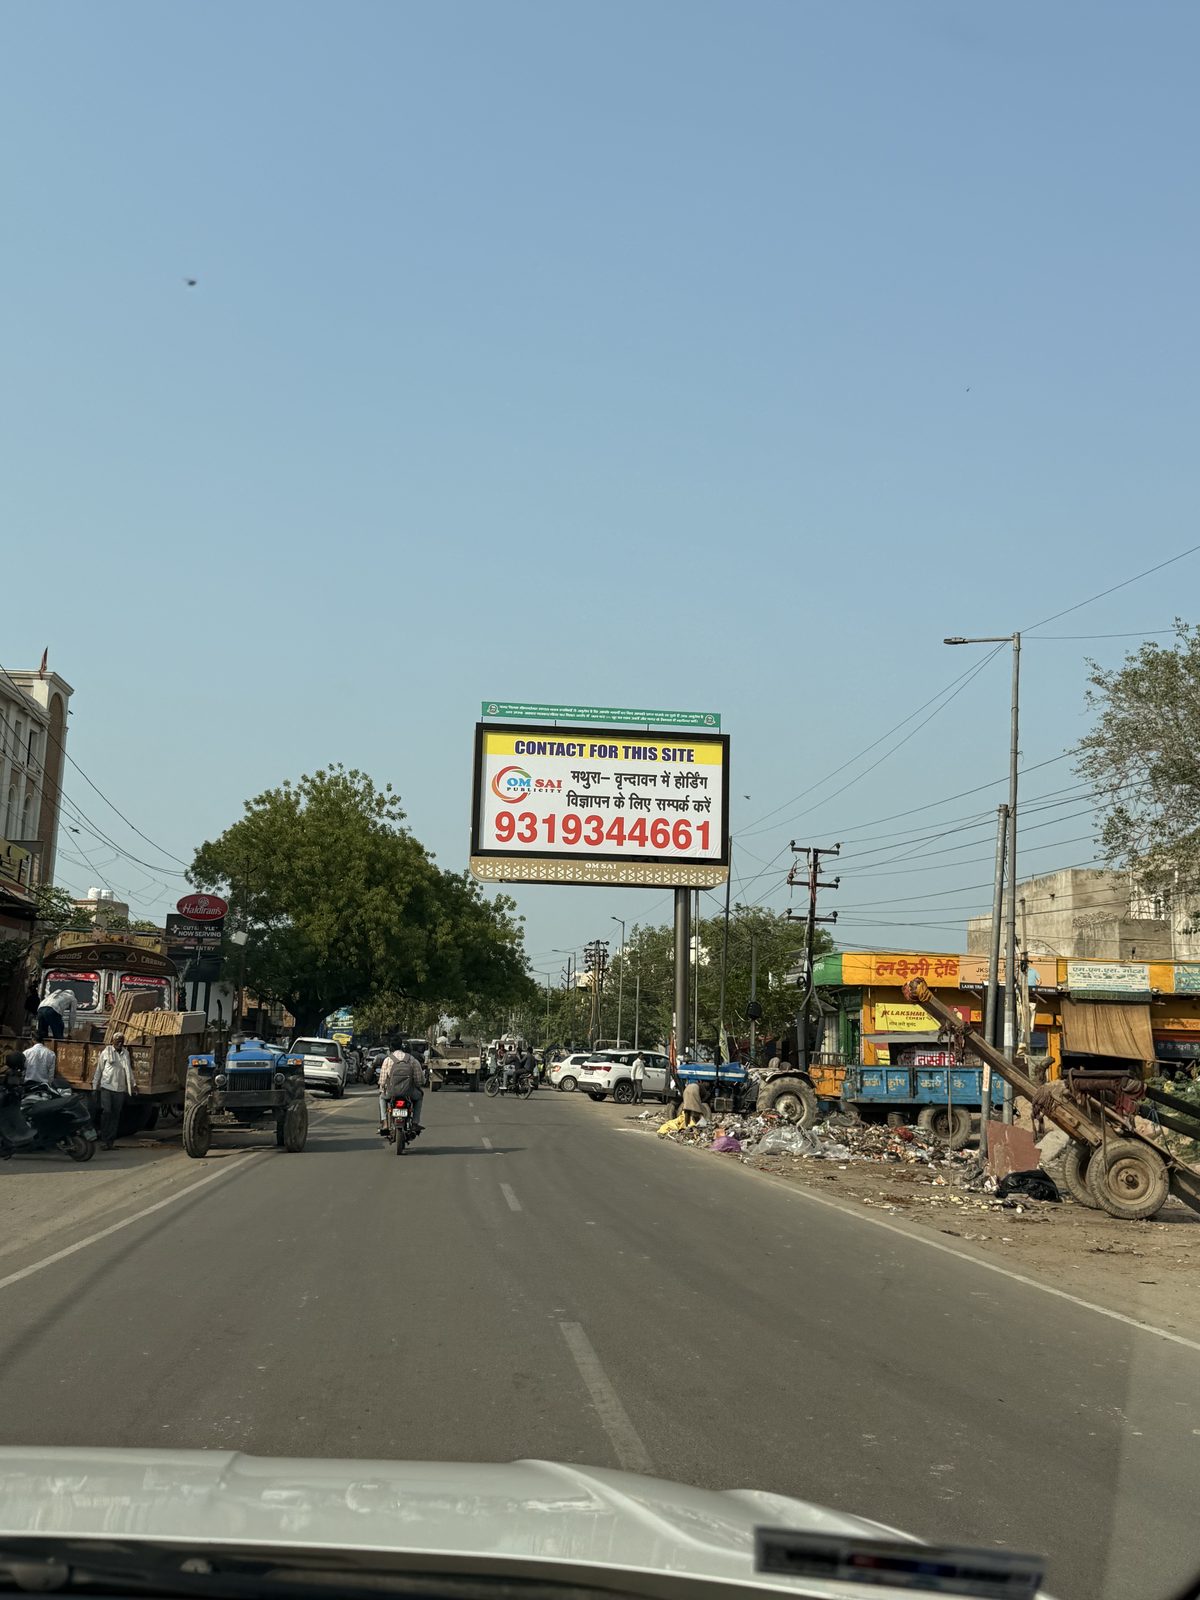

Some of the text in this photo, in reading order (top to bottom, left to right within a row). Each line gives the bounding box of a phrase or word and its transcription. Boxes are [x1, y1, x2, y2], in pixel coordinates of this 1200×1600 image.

[514, 740, 695, 763] CONTACT FOR THIS SITE
[506, 777, 563, 789] OM SAI
[614, 771, 657, 790] वृन्दावन
[660, 770, 672, 788] में
[674, 770, 708, 790] होर्डिंग
[566, 790, 712, 813] विज्ञापन के लिए सम्पर्क करें
[495, 810, 710, 850] 9319344661
[182, 903, 222, 915] Haldiram's
[875, 957, 931, 979] लक्ष्मी
[920, 1075, 942, 1088] कार्य
